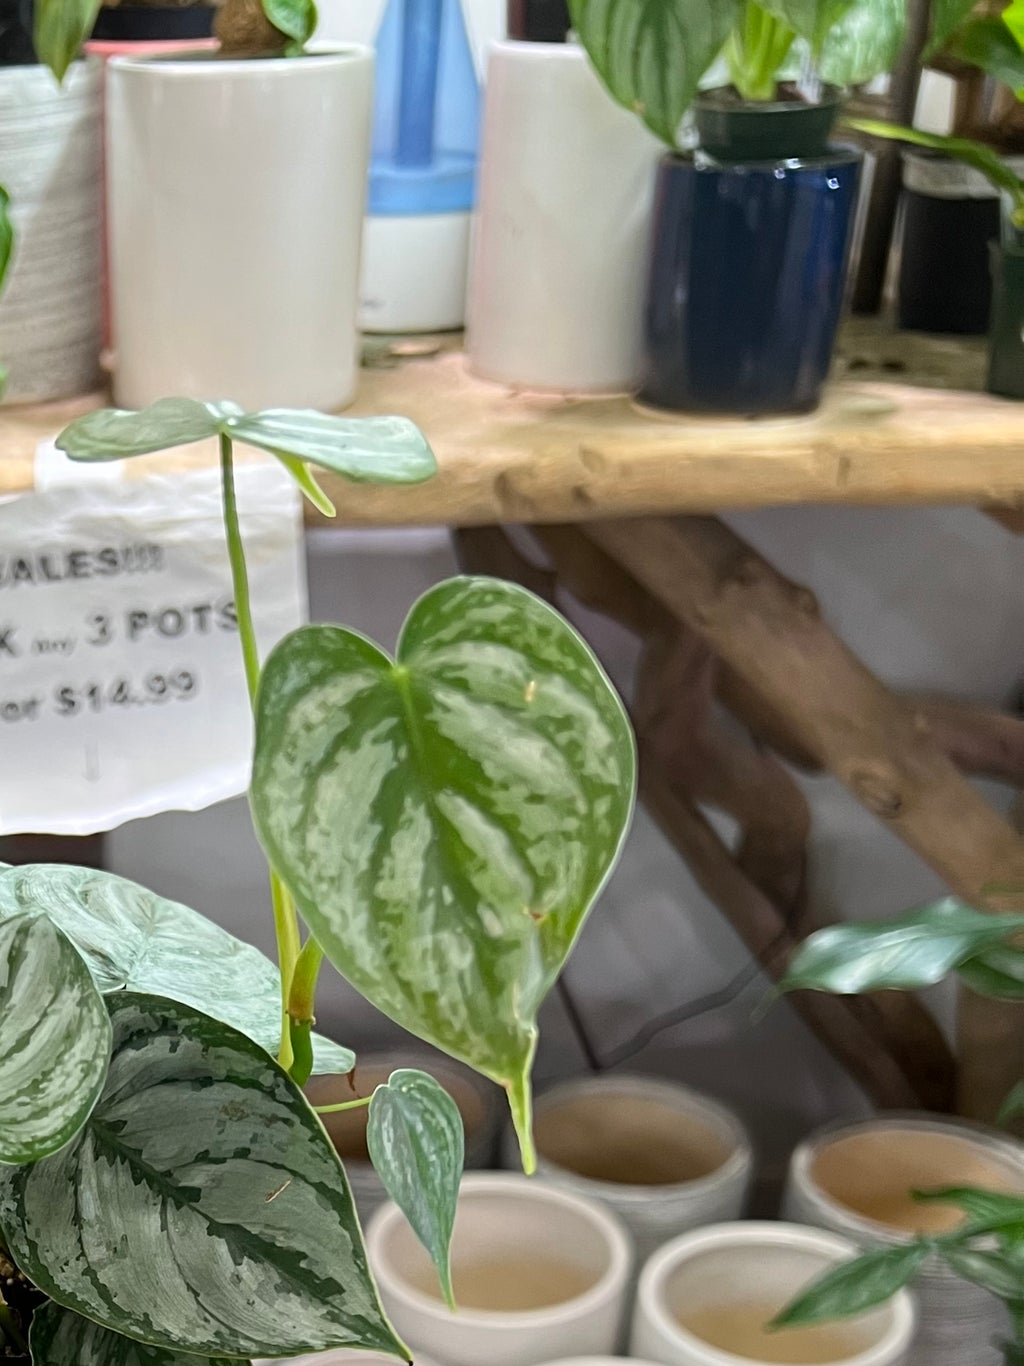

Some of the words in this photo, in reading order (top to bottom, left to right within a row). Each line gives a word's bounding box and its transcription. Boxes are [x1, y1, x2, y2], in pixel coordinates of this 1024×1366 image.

[86, 613, 112, 646] 3
[128, 601, 239, 641] POTS
[54, 670, 196, 717] $14.99
